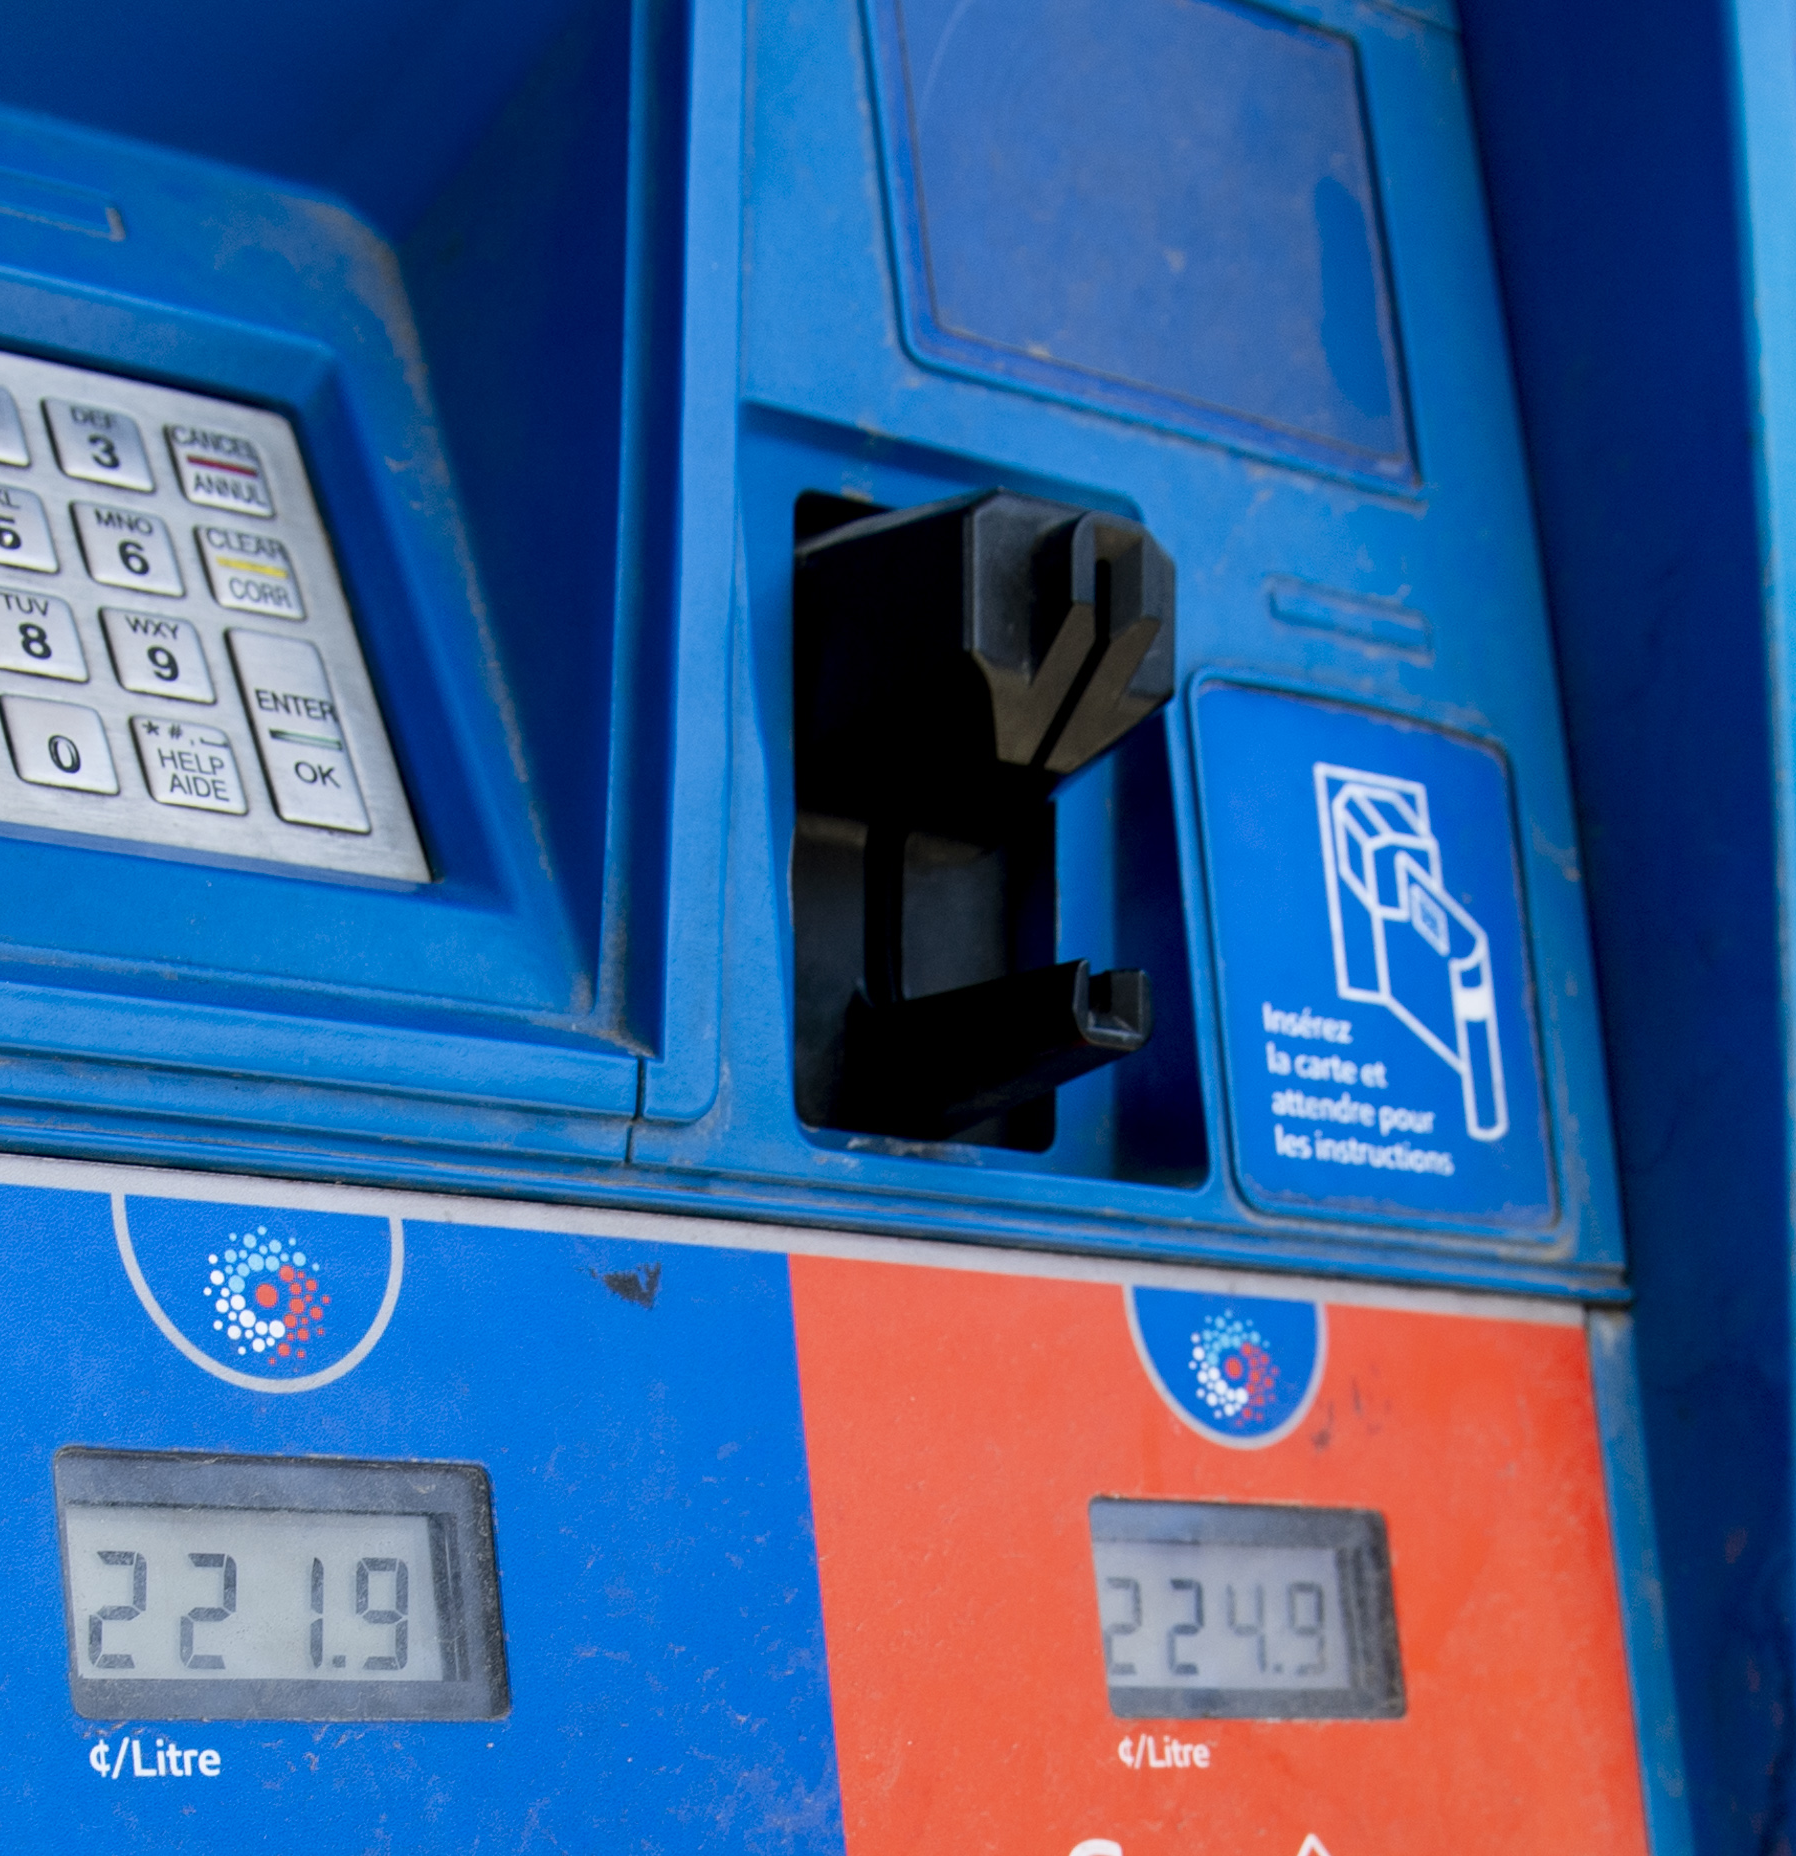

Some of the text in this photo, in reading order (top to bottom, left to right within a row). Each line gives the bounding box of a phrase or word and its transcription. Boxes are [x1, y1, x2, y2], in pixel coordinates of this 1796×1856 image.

[70, 405, 116, 431] DEF
[88, 434, 120, 469] 3
[171, 424, 259, 462] CANCEL
[194, 472, 270, 507] ANNUL
[94, 508, 153, 536] MNO
[118, 539, 150, 575] 6
[206, 527, 290, 562] CLEAR
[228, 577, 292, 609] CORR
[19, 623, 52, 660] 8
[126, 615, 180, 641] WXY
[147, 646, 179, 682] 9
[255, 688, 339, 724] ENTER
[48, 734, 81, 774] 0
[157, 748, 225, 776] HELP
[169, 773, 230, 802] AIDE
[294, 760, 341, 789] OK
[1262, 1001, 1354, 1044] Insérez
[1265, 1040, 1389, 1089] la carte et
[1271, 1088, 1436, 1137] attendre pour
[1274, 1122, 1455, 1177] les instructions
[88, 1550, 410, 1671] 221.9
[1104, 1576, 1326, 1677] 224.9
[90, 1737, 222, 1780] ¢/Litre
[1118, 1733, 1210, 1770] ¢/Litre
